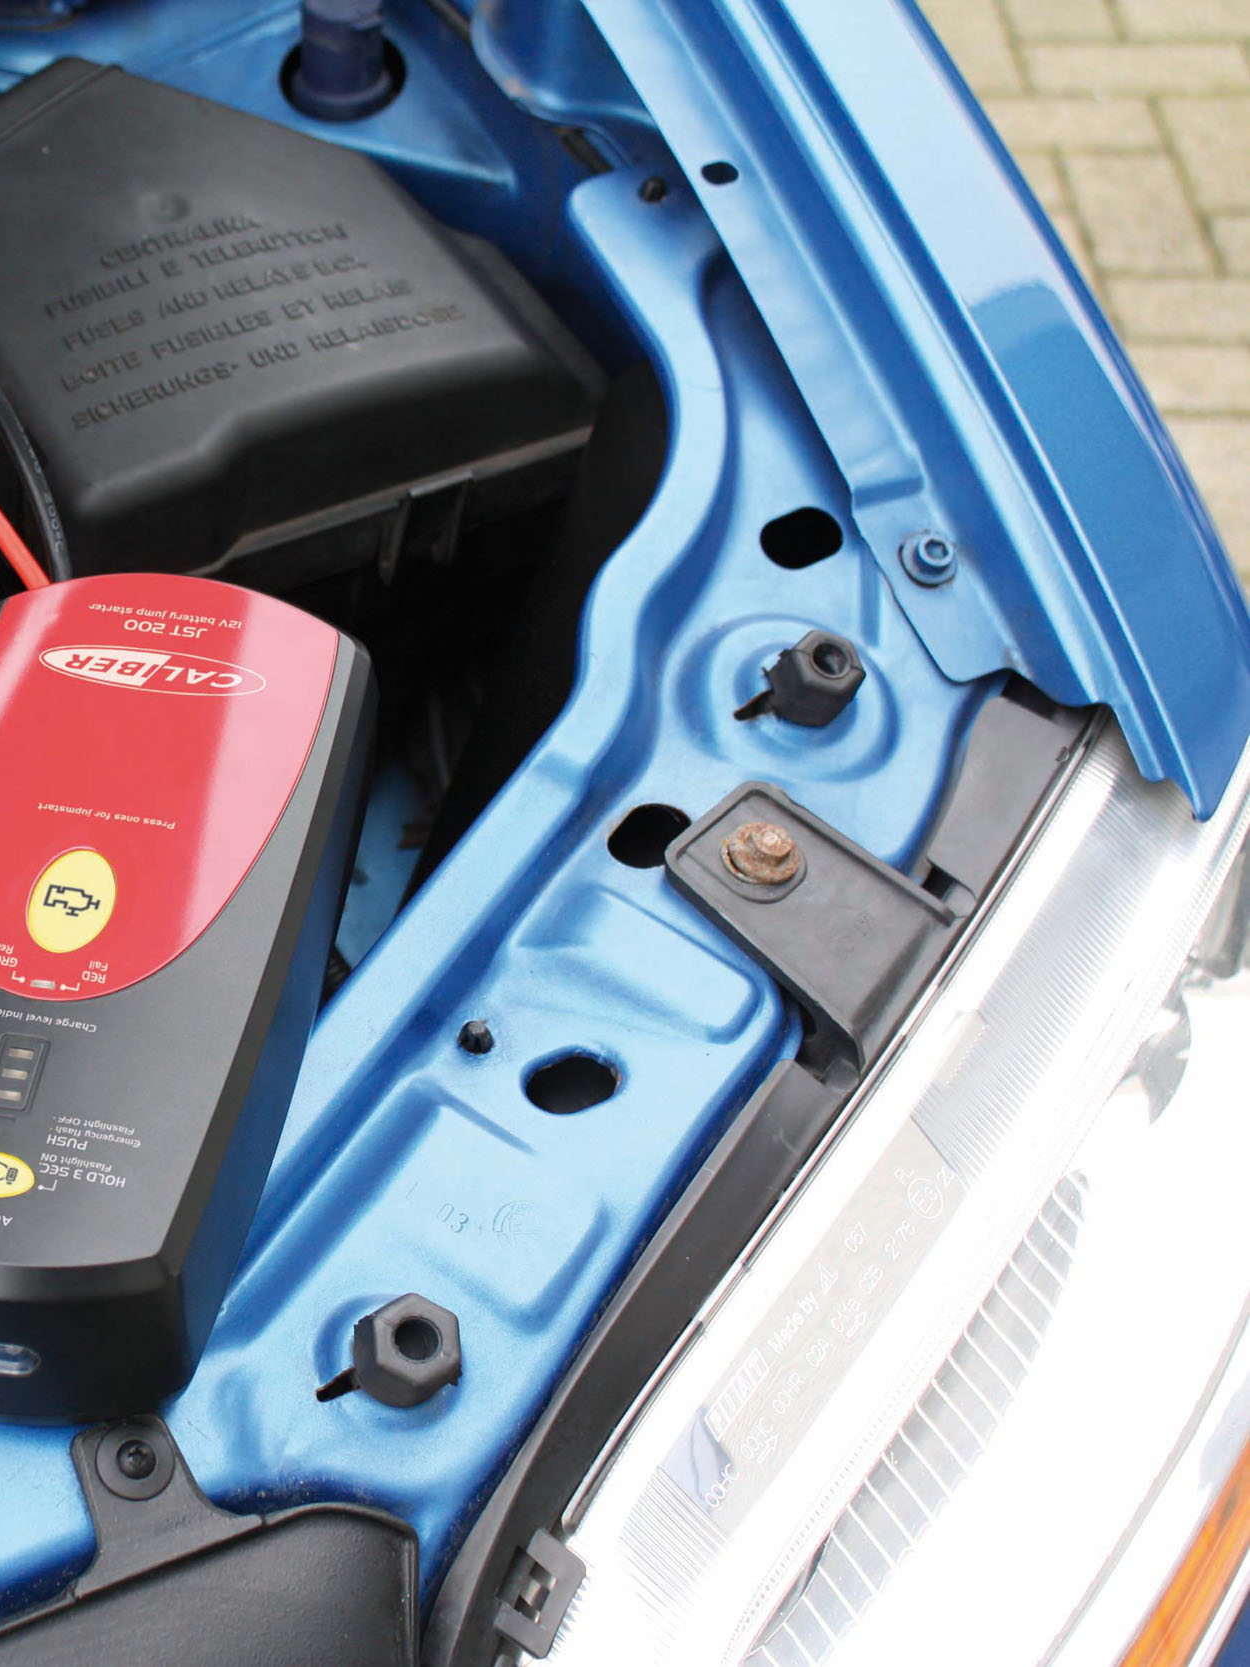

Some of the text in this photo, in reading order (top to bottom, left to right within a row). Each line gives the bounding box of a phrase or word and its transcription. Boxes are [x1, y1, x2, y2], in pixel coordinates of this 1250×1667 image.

[61, 307, 149, 354] FUSES
[157, 287, 210, 321] AND
[212, 260, 312, 305] RELAYS
[150, 307, 275, 362] FUSIBLES
[281, 296, 320, 323] ET
[322, 272, 415, 316] RELAIS
[248, 340, 305, 371] UND
[88, 603, 243, 630] 12V battery jump starter
[123, 619, 208, 639] JST 200
[65, 652, 243, 688] CALIBER
[93, 811, 111, 821] for
[113, 813, 141, 823] ones
[143, 817, 176, 830] Press
[88, 960, 109, 972] Fail
[81, 970, 107, 984] RED
[25, 1013, 53, 1026] level
[55, 1017, 97, 1033] Charge
[57, 1116, 135, 1136] Flashlight OFF
[46, 1134, 88, 1151] PUSH
[55, 1125, 142, 1149] Emergency flash
[40, 1152, 113, 1173] Flashlight ON
[38, 1160, 127, 1188] HOLD 3 SEC.
[767, 1309, 808, 1354] Made
[796, 1289, 825, 1318] by
